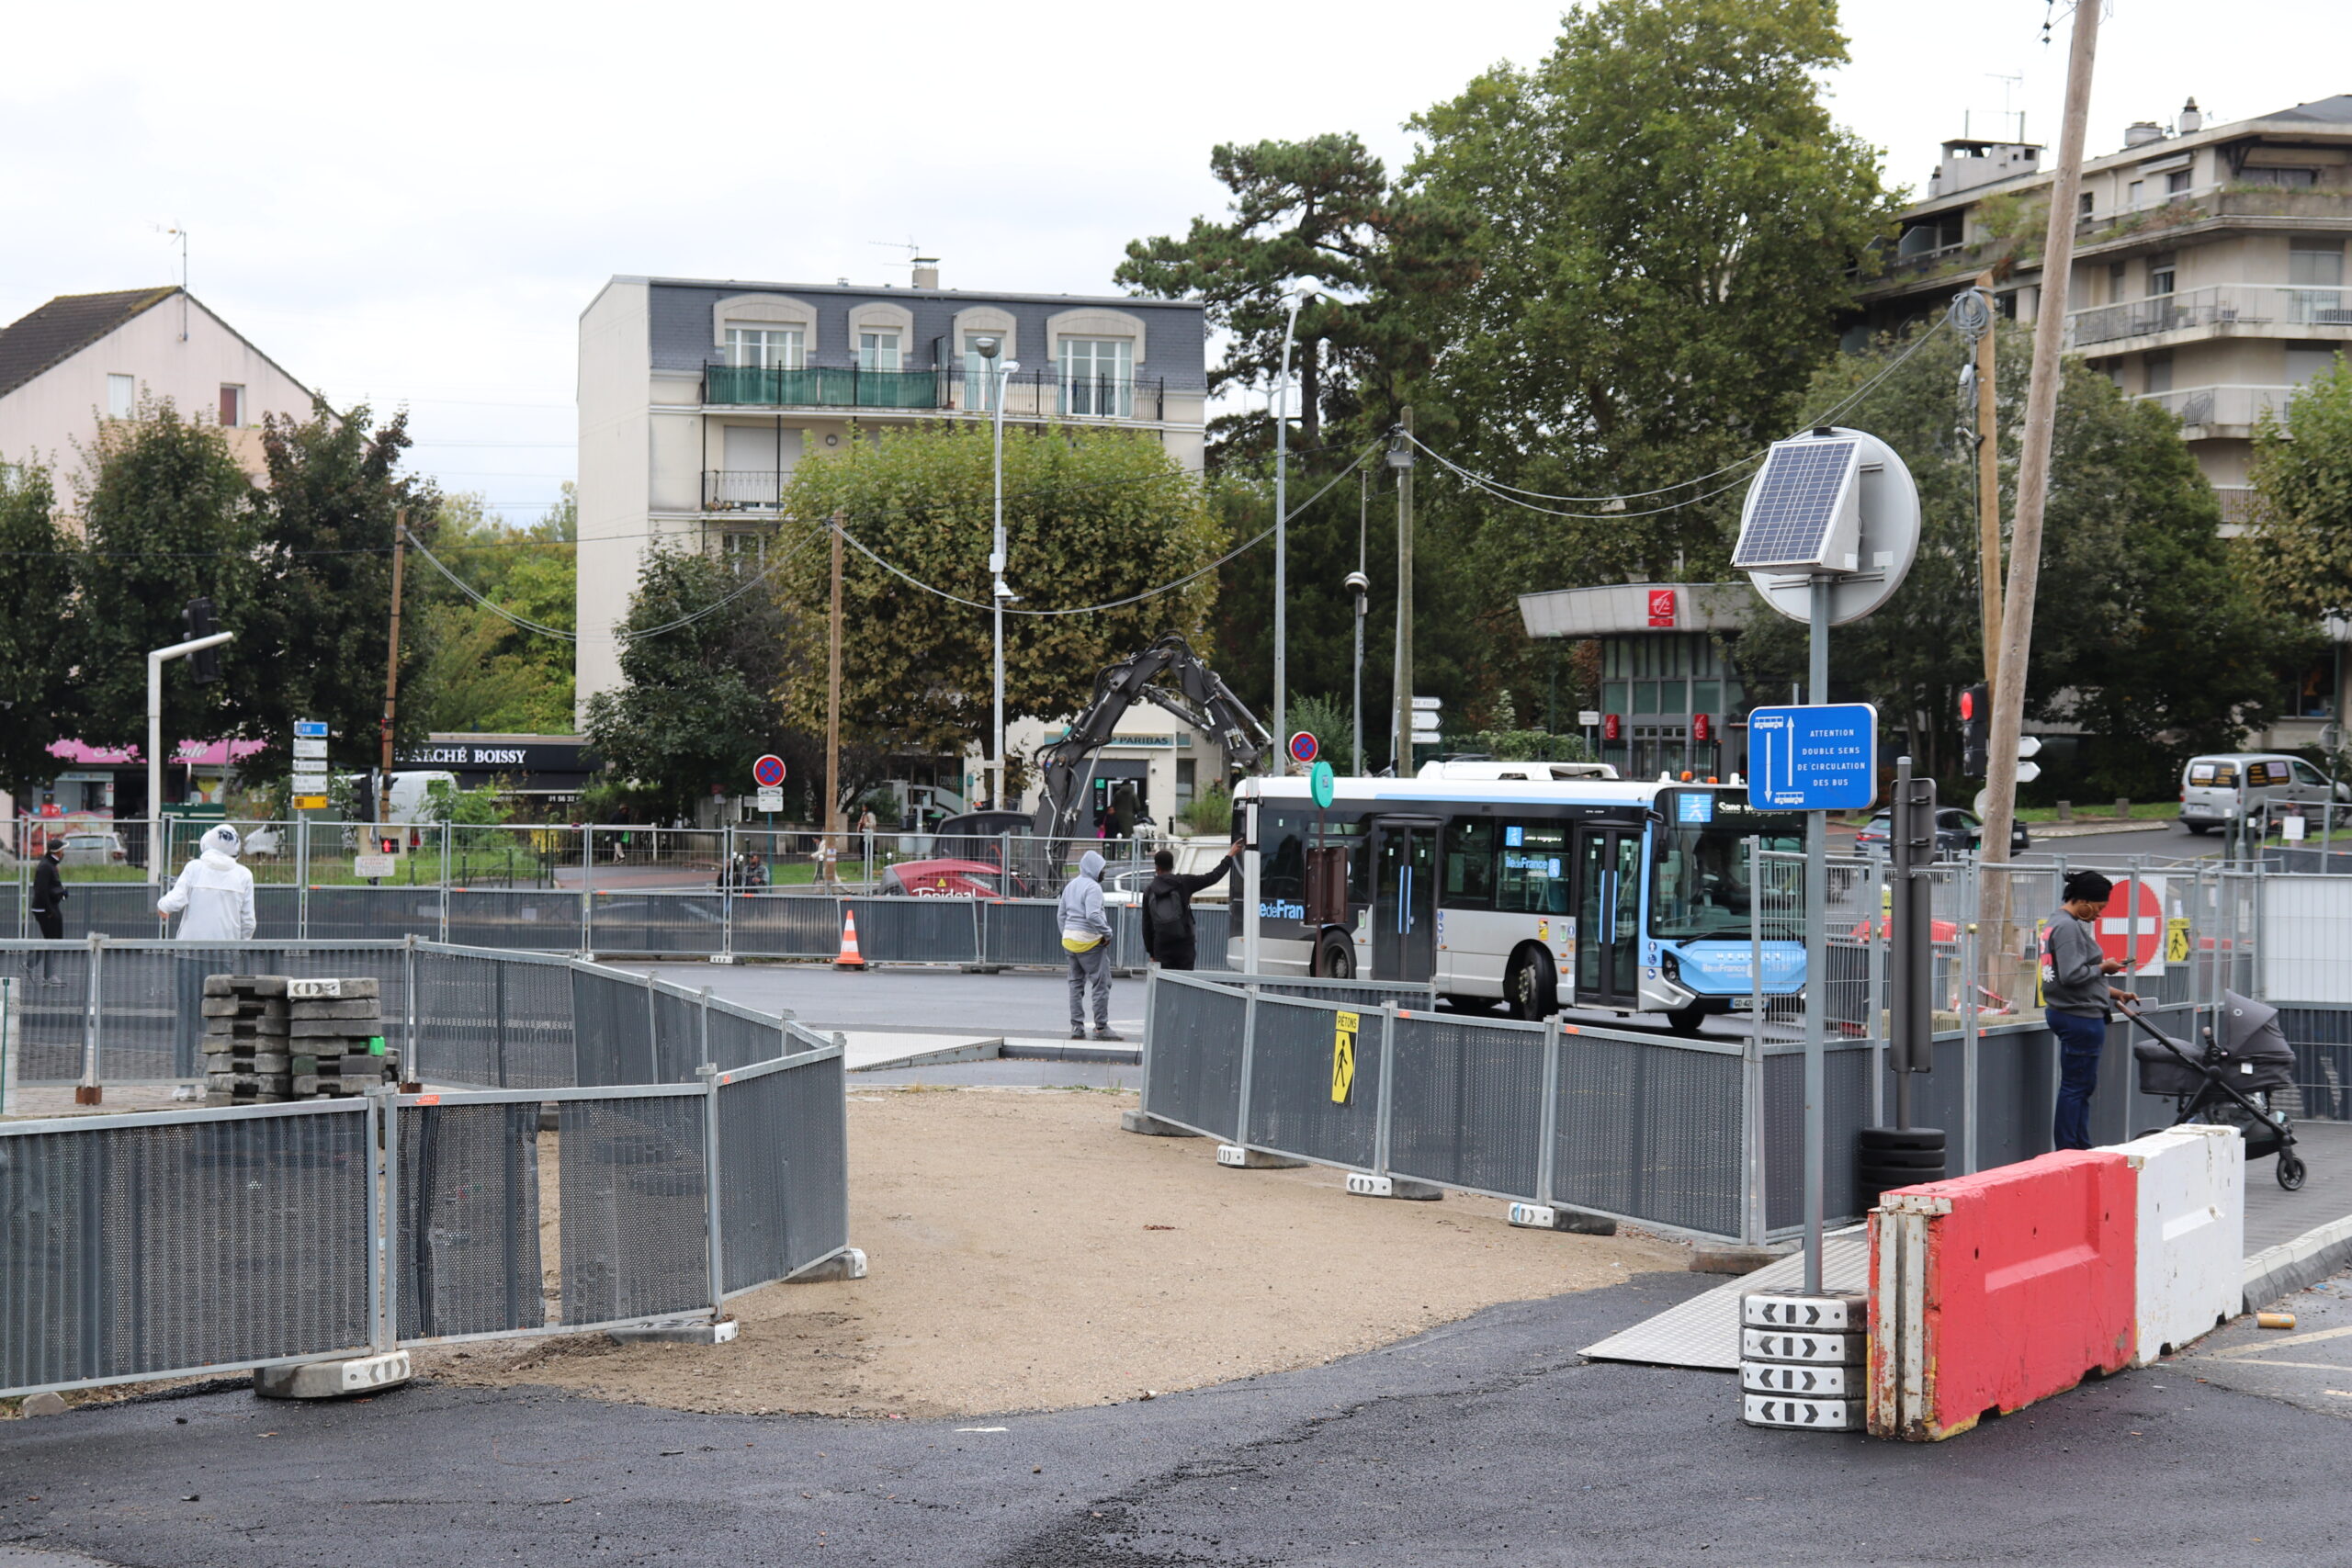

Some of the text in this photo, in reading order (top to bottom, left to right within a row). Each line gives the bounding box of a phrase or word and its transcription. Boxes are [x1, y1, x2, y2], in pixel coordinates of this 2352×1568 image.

[1809, 728, 1855, 738] ATTENTION
[473, 750, 526, 764] BOISSY
[1802, 746, 1860, 756] DOUBLE SENS
[1797, 761, 1866, 772] DE CIRCULATION
[1813, 778, 1849, 787] DES BUS
[1717, 801, 1742, 814] Sans
[1260, 899, 1305, 919] edeFran
[1338, 1014, 1357, 1029] PIÉTONS
